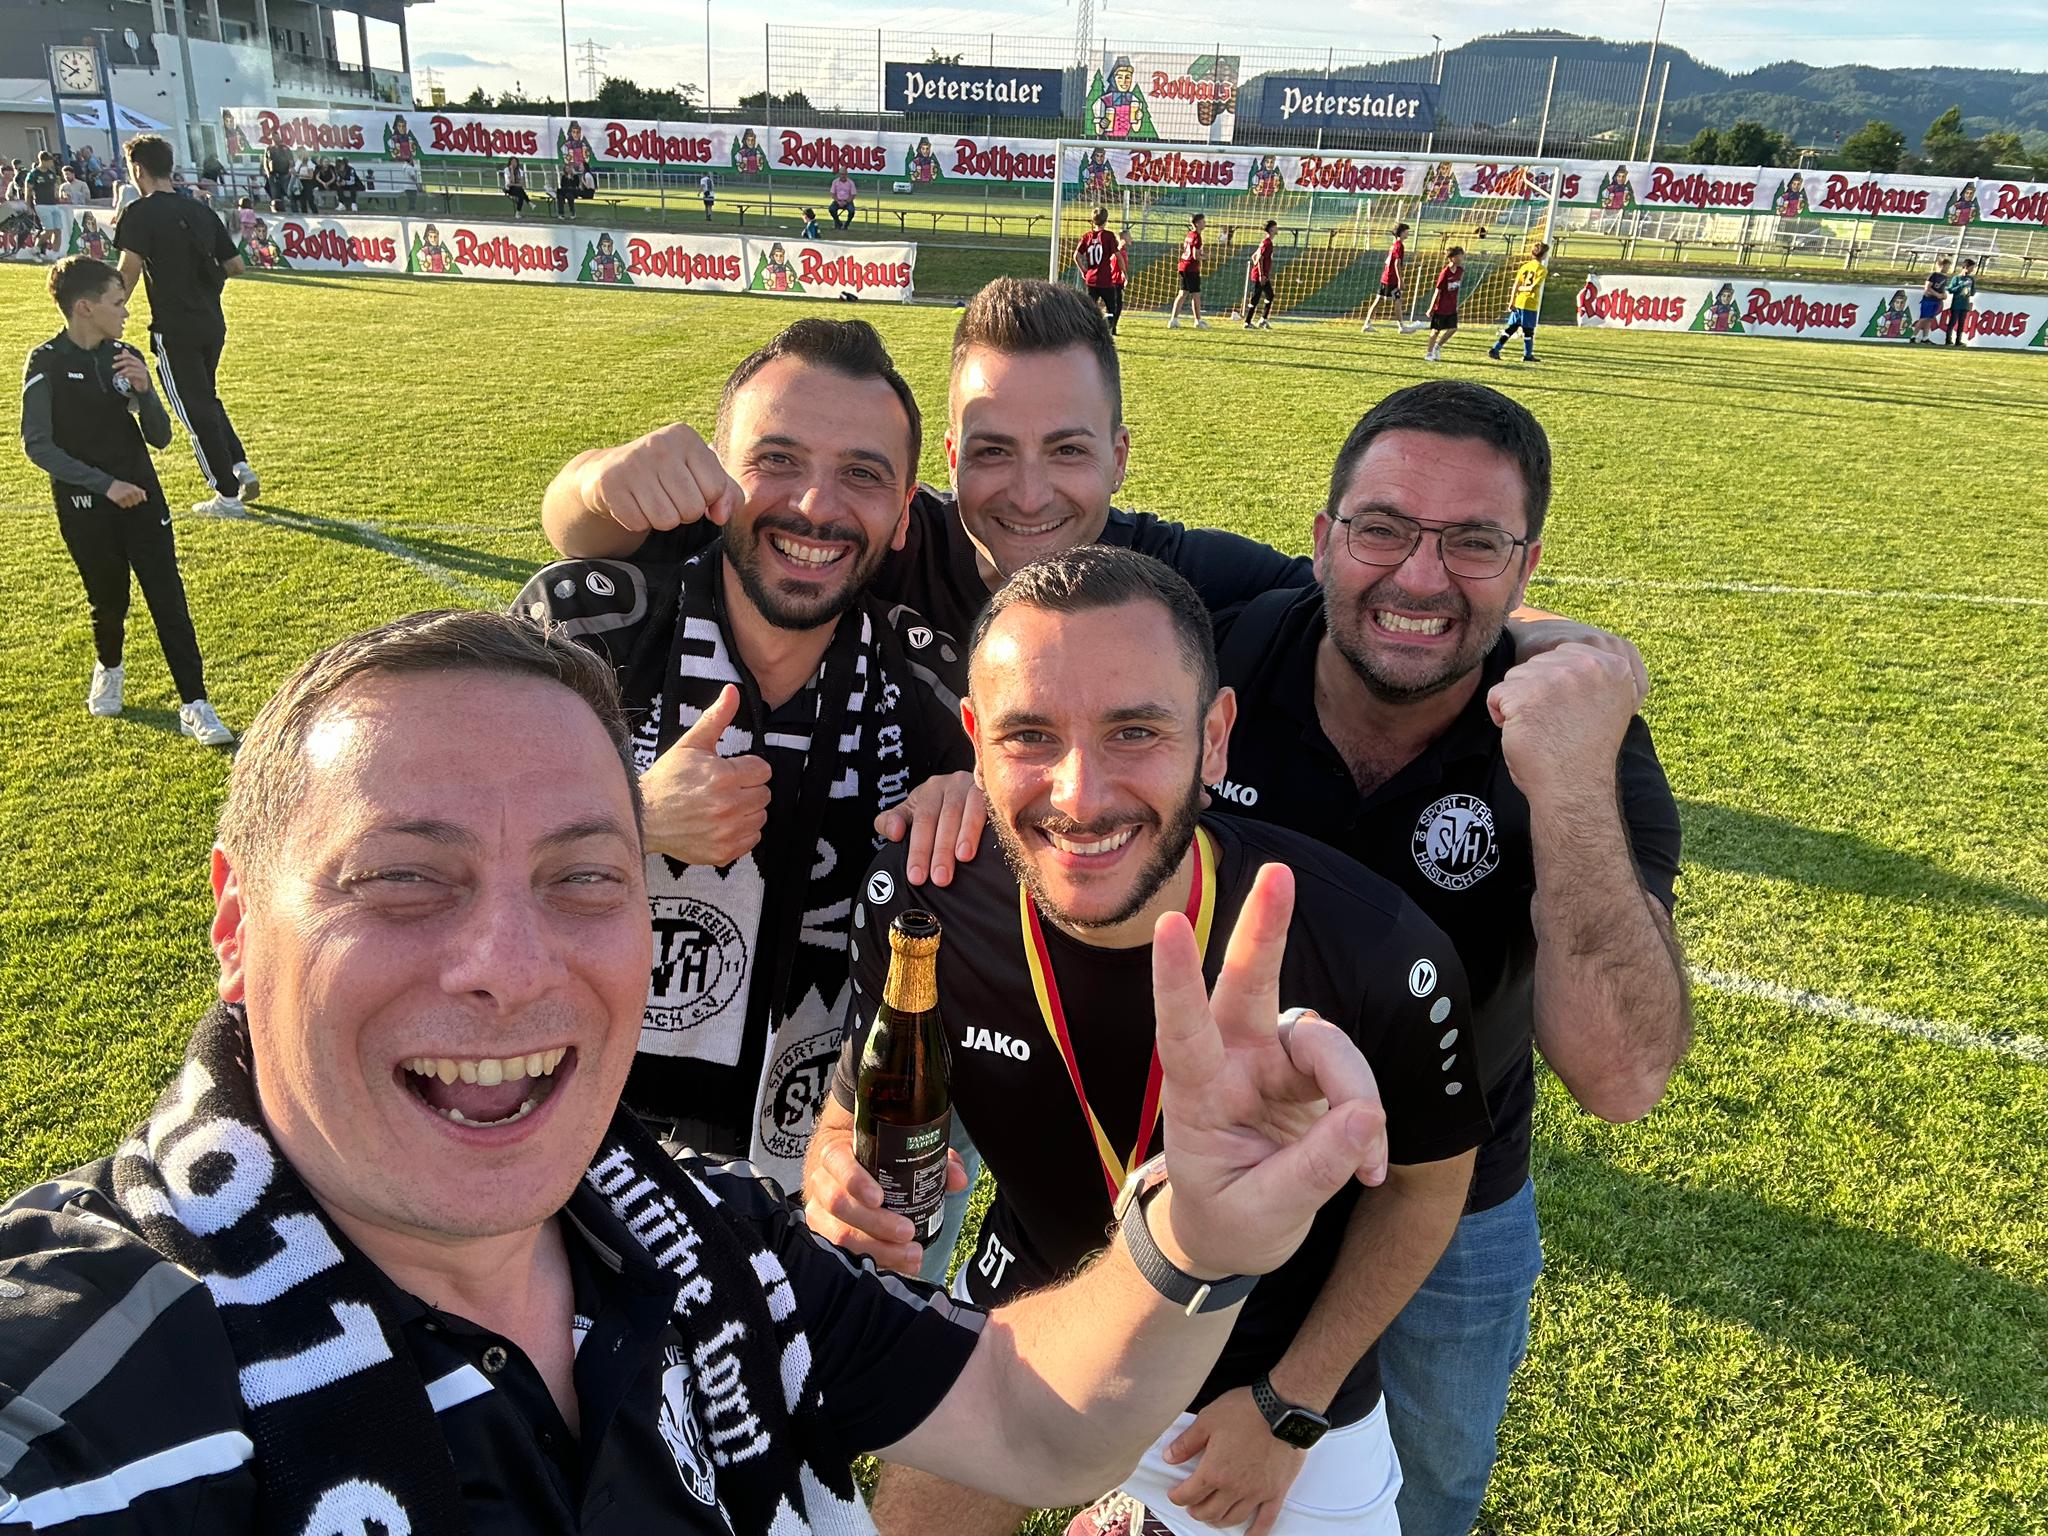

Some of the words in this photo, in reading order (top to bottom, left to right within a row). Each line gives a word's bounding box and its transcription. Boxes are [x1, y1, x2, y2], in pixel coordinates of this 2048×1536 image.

[903, 71, 1042, 104] Peterstaler
[1148, 71, 1234, 104] Rothaus
[1280, 87, 1420, 120] Peterstaler
[257, 111, 365, 152] Rothaus
[430, 115, 538, 158] Rothaus
[604, 122, 712, 166] Rothaus
[779, 130, 886, 173] Rothaus
[952, 138, 1056, 181] Rothaus
[1127, 150, 1235, 188] Rothaus
[1296, 154, 1406, 193] Rothaus
[1645, 166, 1757, 209] Rothaus
[1819, 174, 1930, 218] Rothaus
[281, 222, 397, 267] Rothaus
[453, 229, 569, 275] Rothaus
[626, 238, 741, 284] Rothaus
[1087, 243, 1103, 266] 10
[799, 248, 912, 292] Rothaus
[1576, 281, 1688, 327] Rothaus
[1740, 288, 1859, 334] Rothaus
[71, 495, 92, 509] VW
[1211, 777, 1258, 806] AKO
[1415, 830, 1427, 842] 19
[1416, 851, 1474, 889] HASLACH
[961, 1026, 1031, 1062] JAKO
[978, 1232, 1016, 1289] GT
